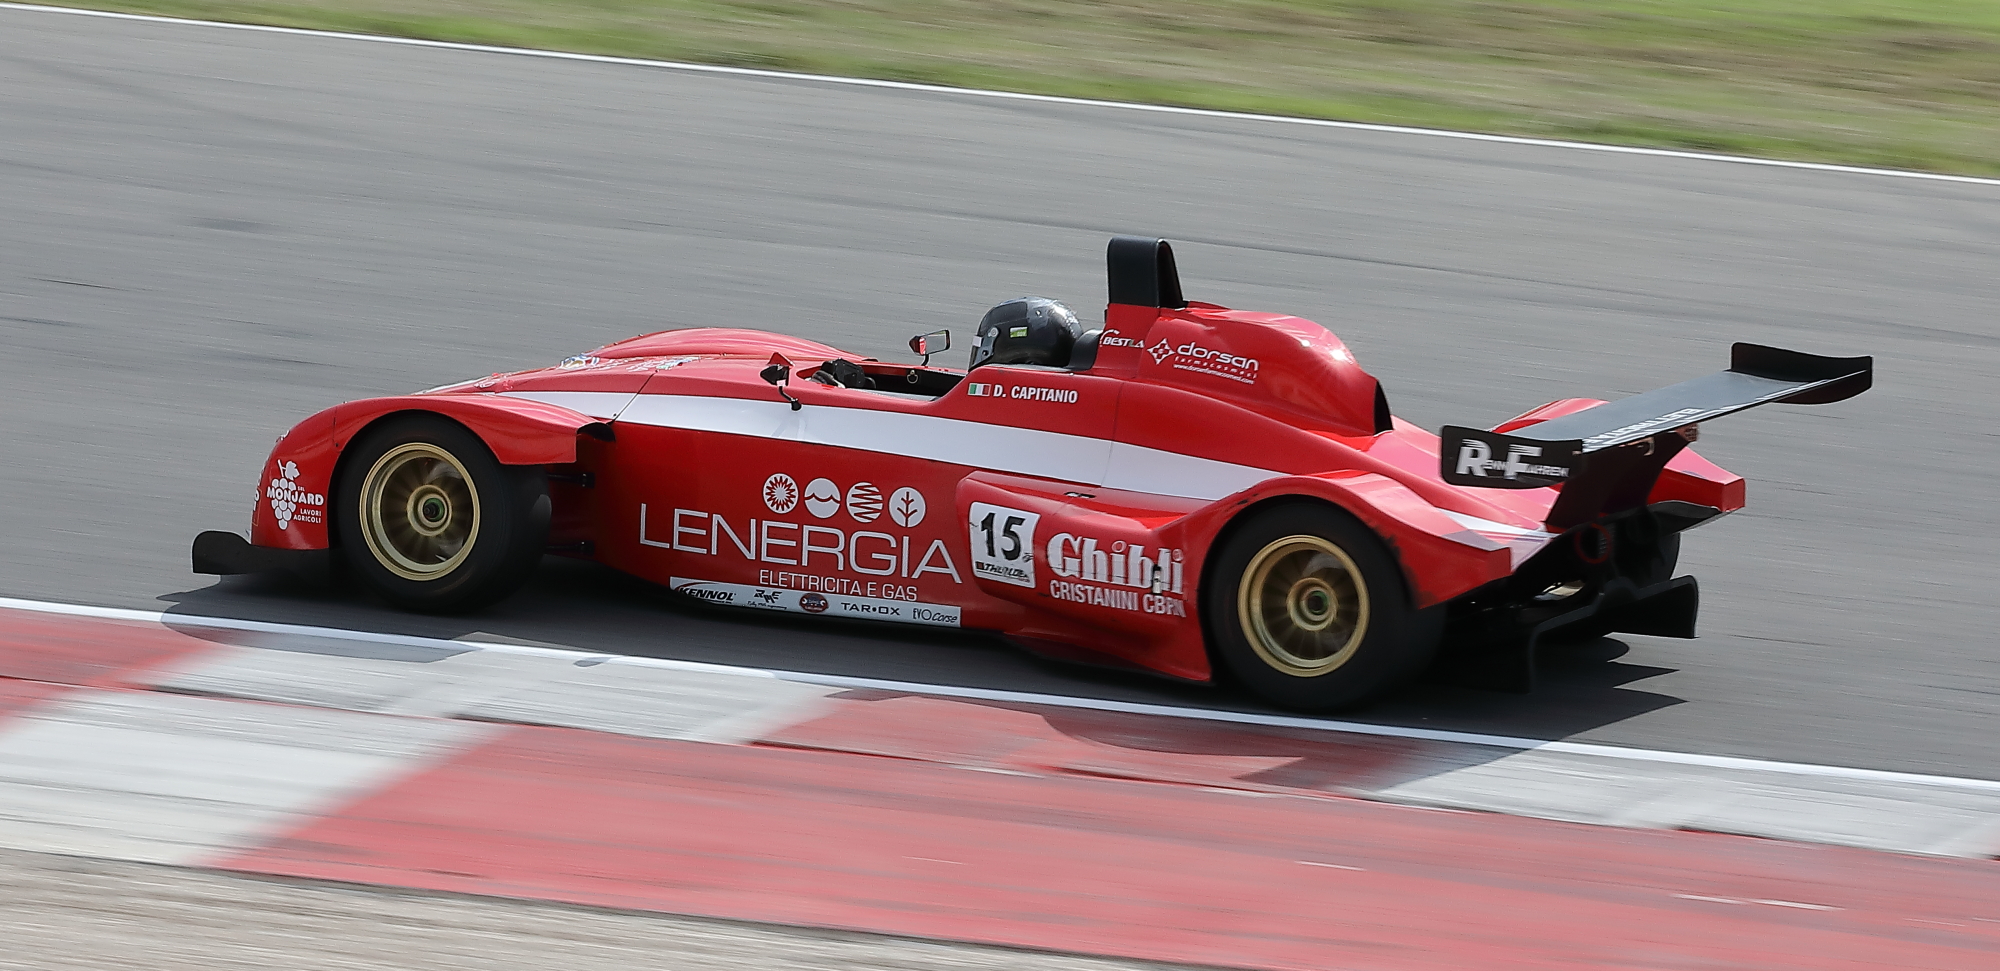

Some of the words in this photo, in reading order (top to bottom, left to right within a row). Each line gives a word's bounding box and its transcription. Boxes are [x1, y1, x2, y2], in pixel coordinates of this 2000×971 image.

[1177, 341, 1259, 371] dorsan
[993, 384, 1007, 398] D.
[1011, 385, 1078, 404] CAPITANIO
[266, 486, 324, 506] MONJARD
[300, 508, 322, 517] LAVORI
[639, 503, 963, 584] LENERGIA
[980, 512, 1026, 561] 15
[1047, 532, 1184, 595] Ghibli
[680, 587, 735, 602] KENNOL
[759, 569, 862, 596] ELETTRICITA
[867, 582, 877, 598] E
[882, 584, 918, 602] GAS
[1049, 580, 1140, 612] CRISTANINI
